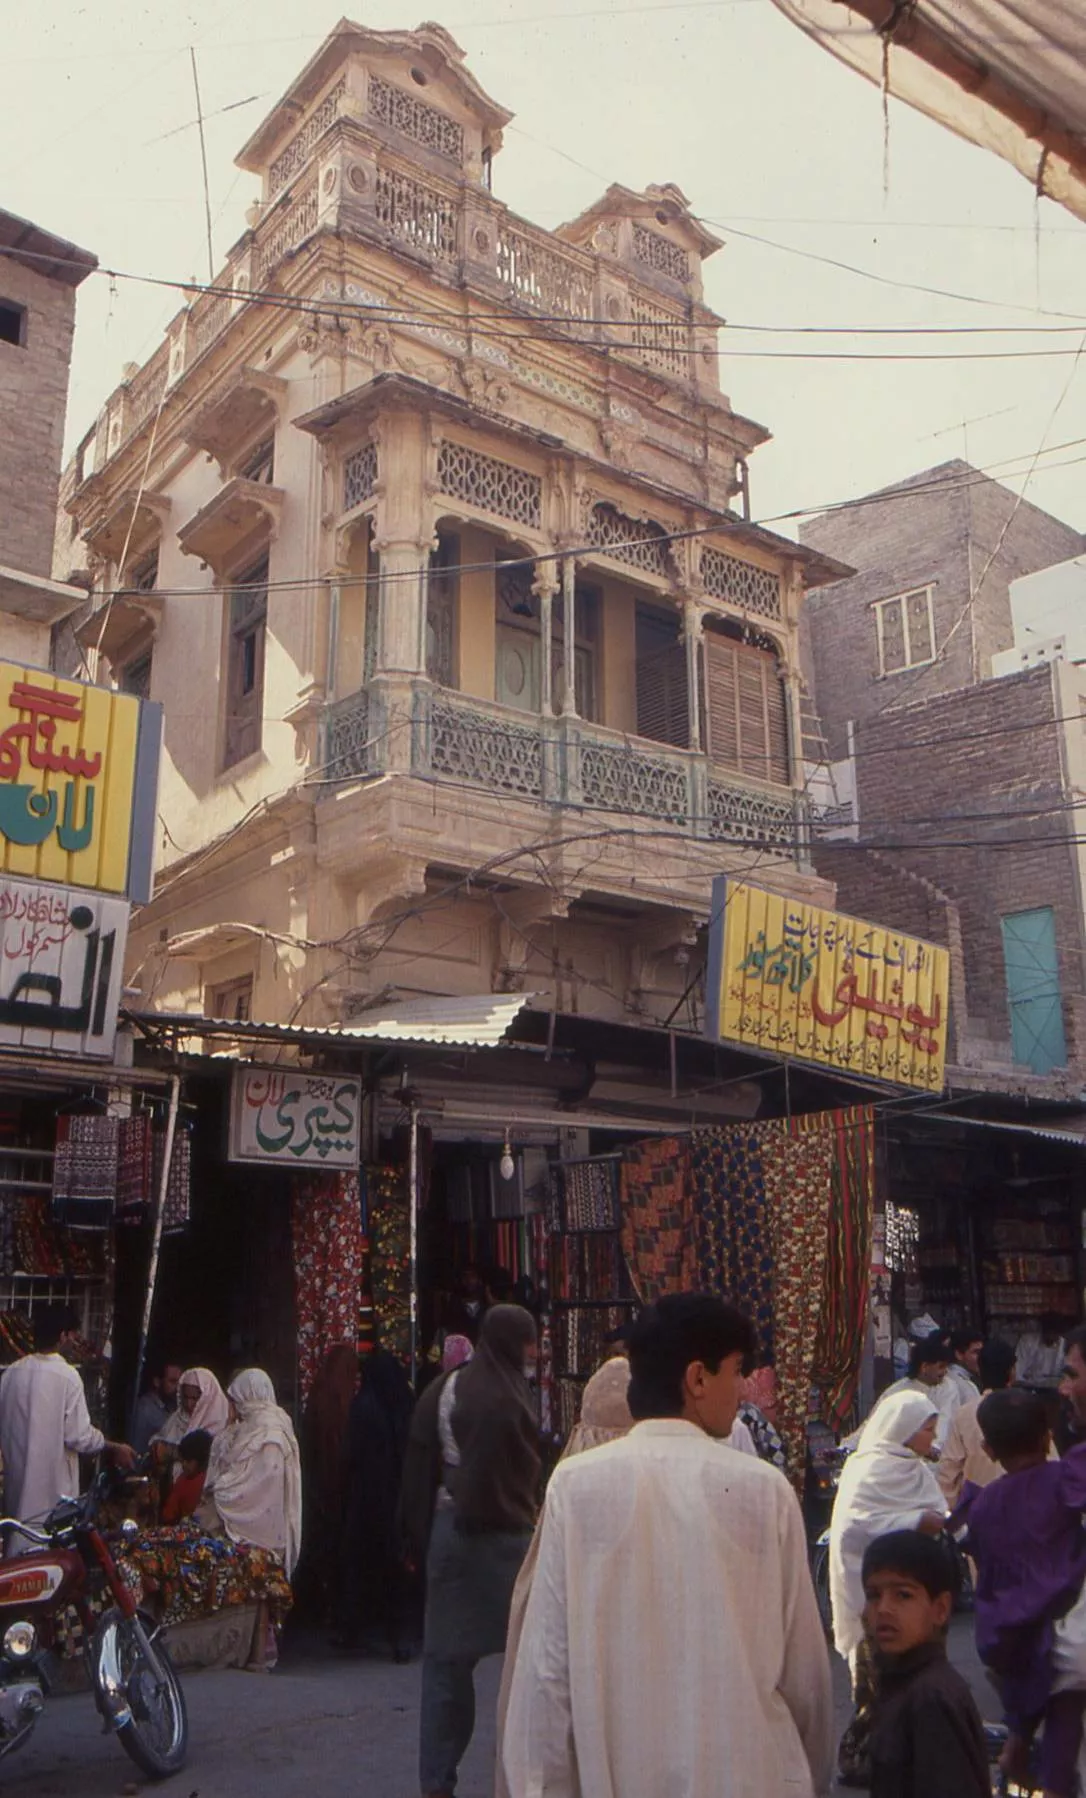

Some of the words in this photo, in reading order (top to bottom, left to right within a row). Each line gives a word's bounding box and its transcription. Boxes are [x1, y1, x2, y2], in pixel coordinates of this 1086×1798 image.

[245, 1072, 286, 1108] لان
[255, 1083, 358, 1159] کیپری
[15, 1577, 55, 1593] YAMAHA
